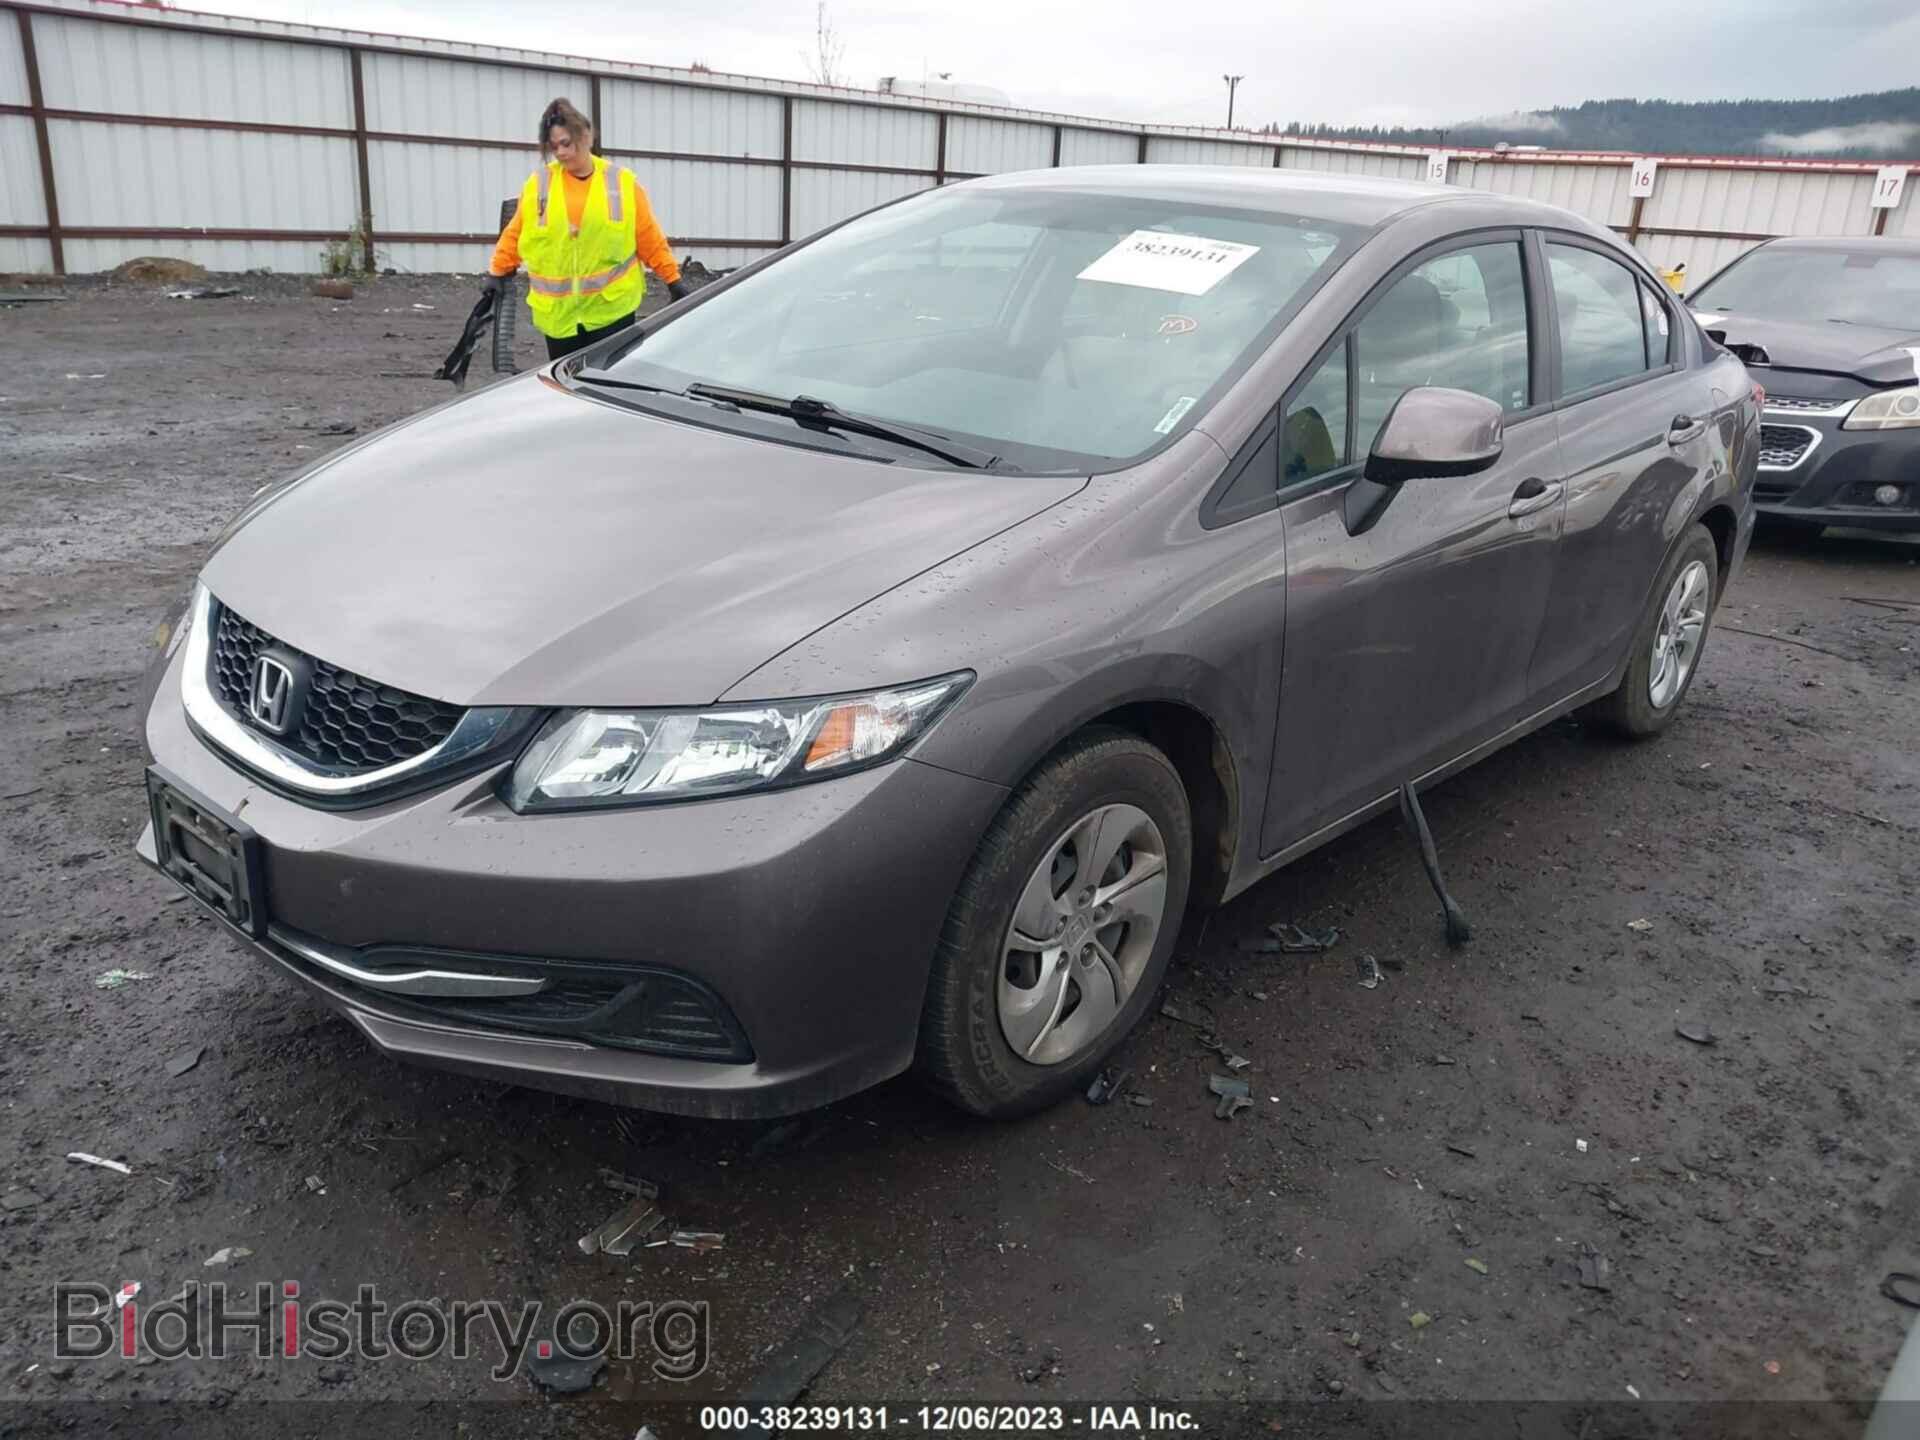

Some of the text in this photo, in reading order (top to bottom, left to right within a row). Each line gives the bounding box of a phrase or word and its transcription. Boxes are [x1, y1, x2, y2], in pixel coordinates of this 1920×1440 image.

[1431, 163, 1444, 178] 15
[1635, 171, 1650, 187] 16
[1880, 179, 1898, 196] 17
